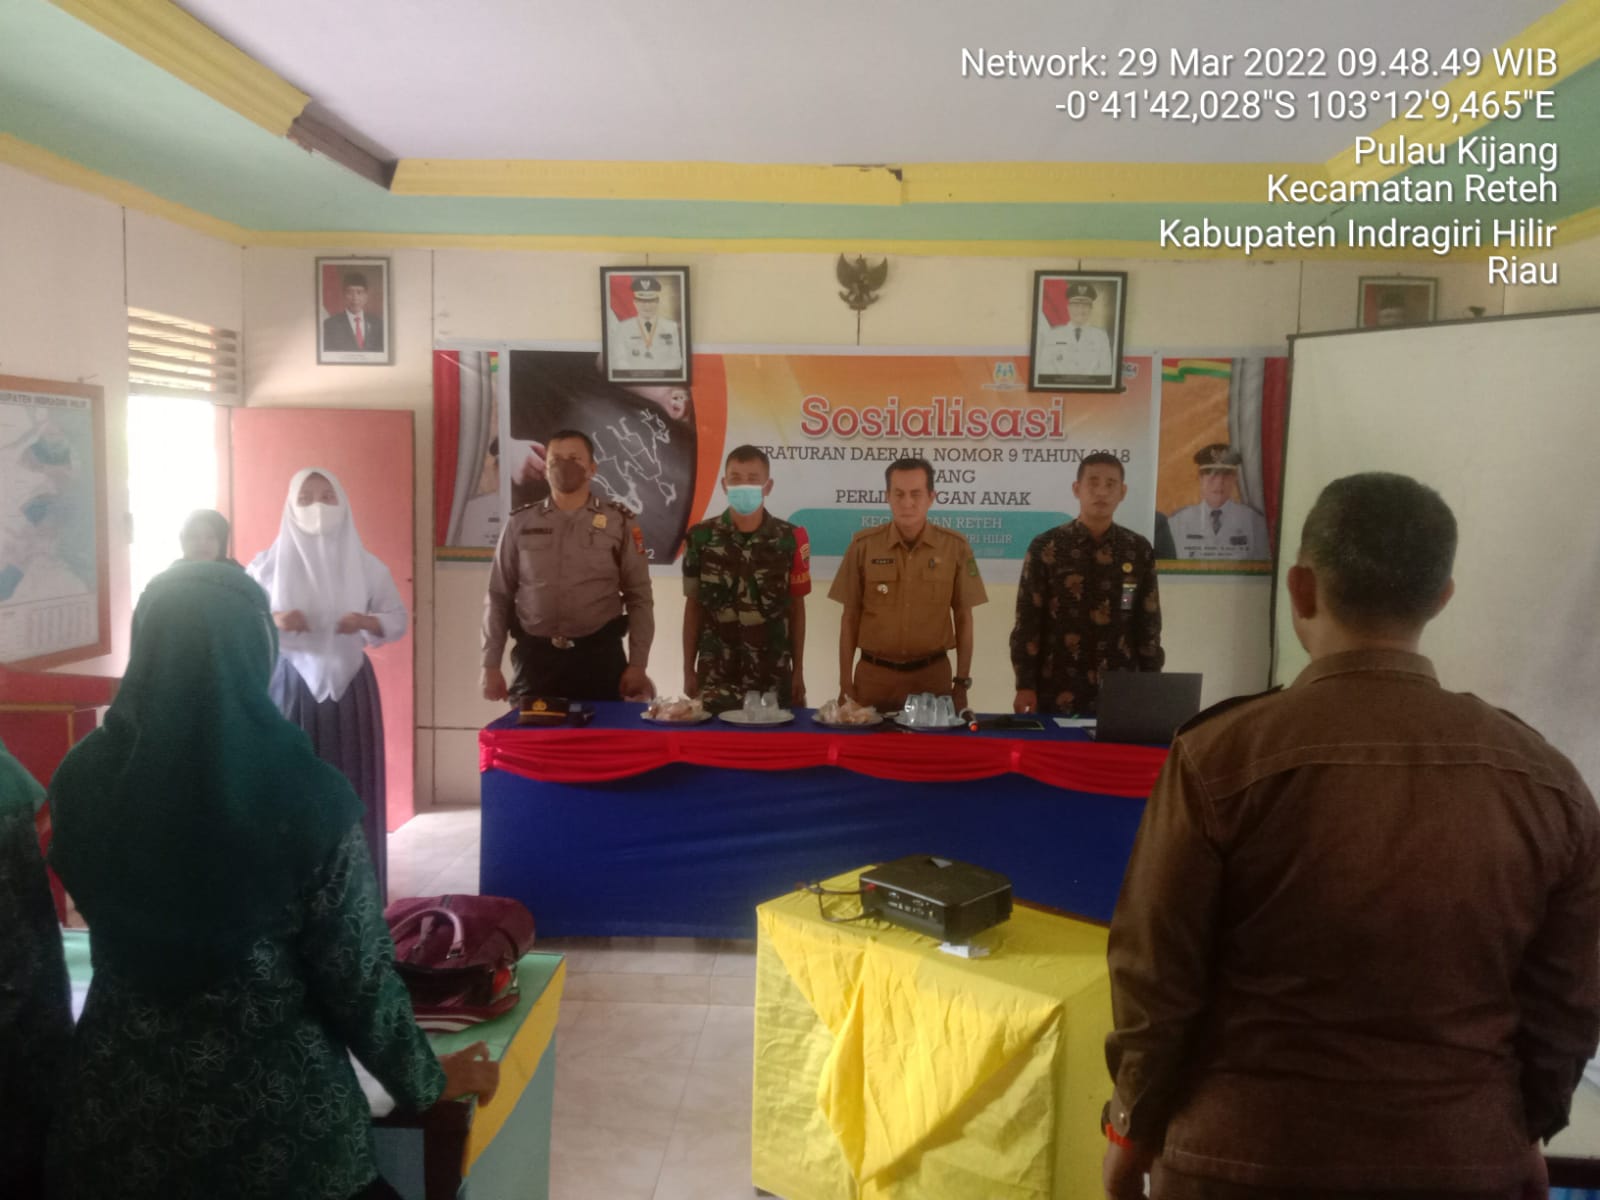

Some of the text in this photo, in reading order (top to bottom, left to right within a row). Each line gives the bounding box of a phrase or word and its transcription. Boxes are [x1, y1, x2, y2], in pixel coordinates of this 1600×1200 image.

[800, 396, 1064, 438] Sosialisasi
[850, 447, 923, 462] DAERAH
[933, 447, 1004, 463] NOMOR
[1008, 448, 1019, 463] 9
[1022, 448, 1086, 463] TAHUN
[979, 491, 1032, 506] ANAK
[956, 516, 1003, 529] RETEH
